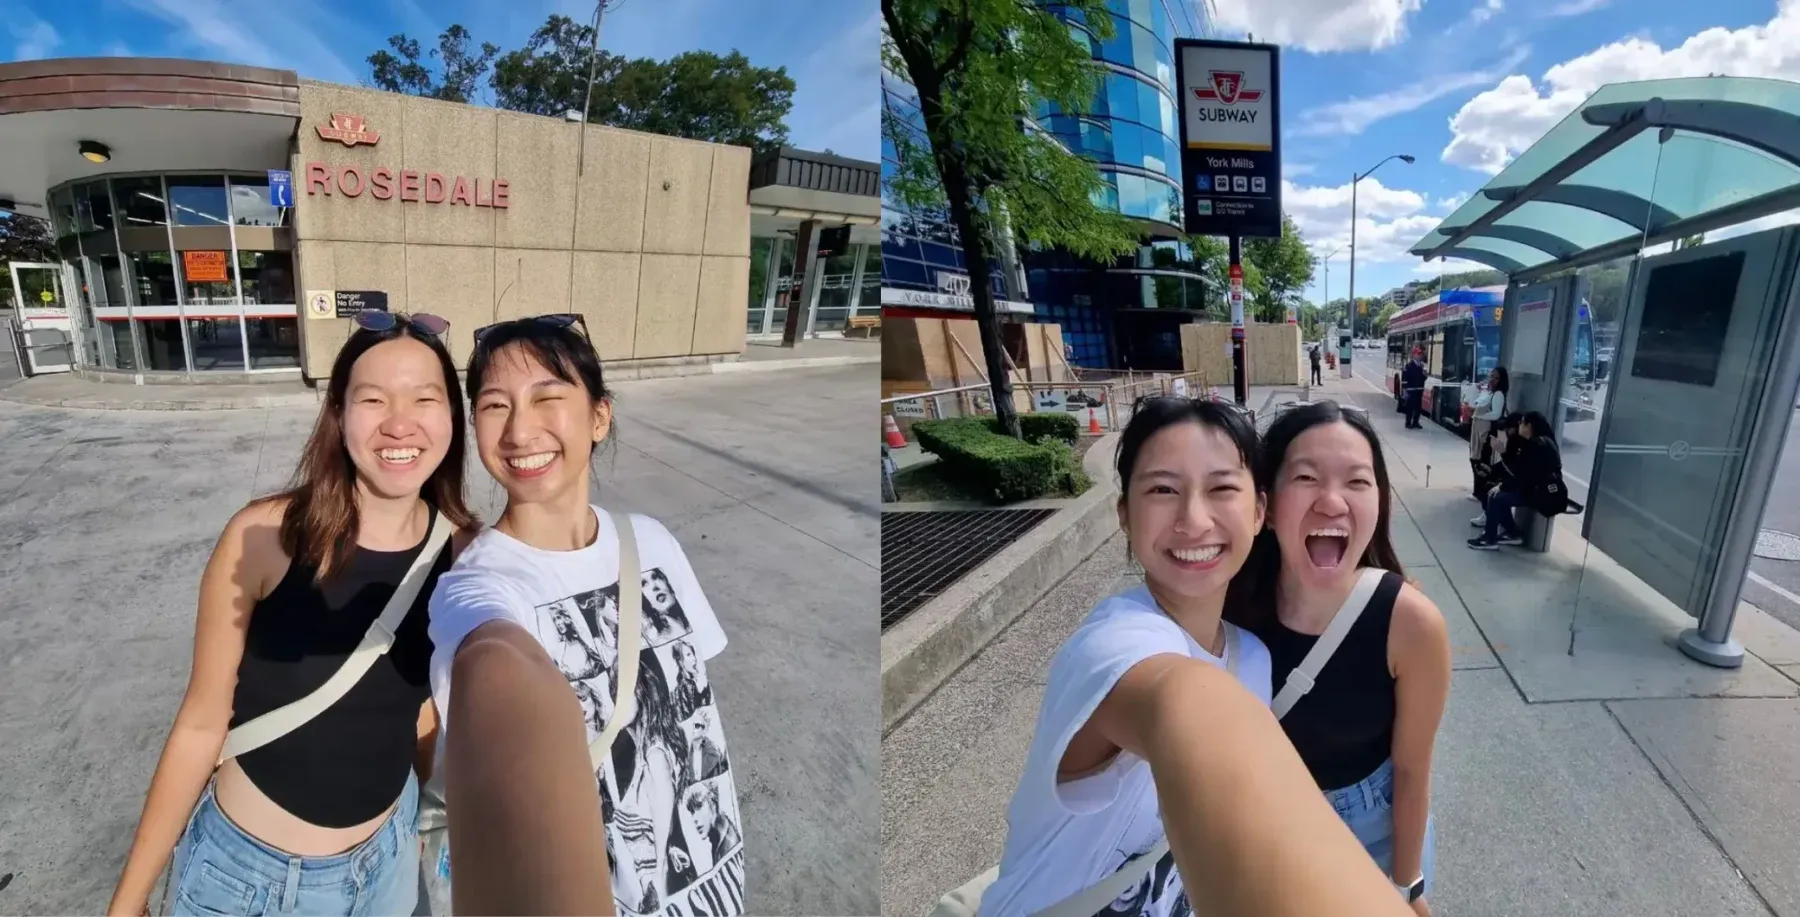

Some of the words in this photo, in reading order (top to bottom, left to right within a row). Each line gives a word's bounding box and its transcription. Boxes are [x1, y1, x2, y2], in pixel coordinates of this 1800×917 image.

[1199, 107, 1258, 123] SUBWAY
[1206, 156, 1228, 168] York
[1231, 158, 1255, 169] Mills
[306, 162, 510, 208] ROSEDALE
[337, 293, 361, 301] Danger
[348, 300, 366, 308] Entry
